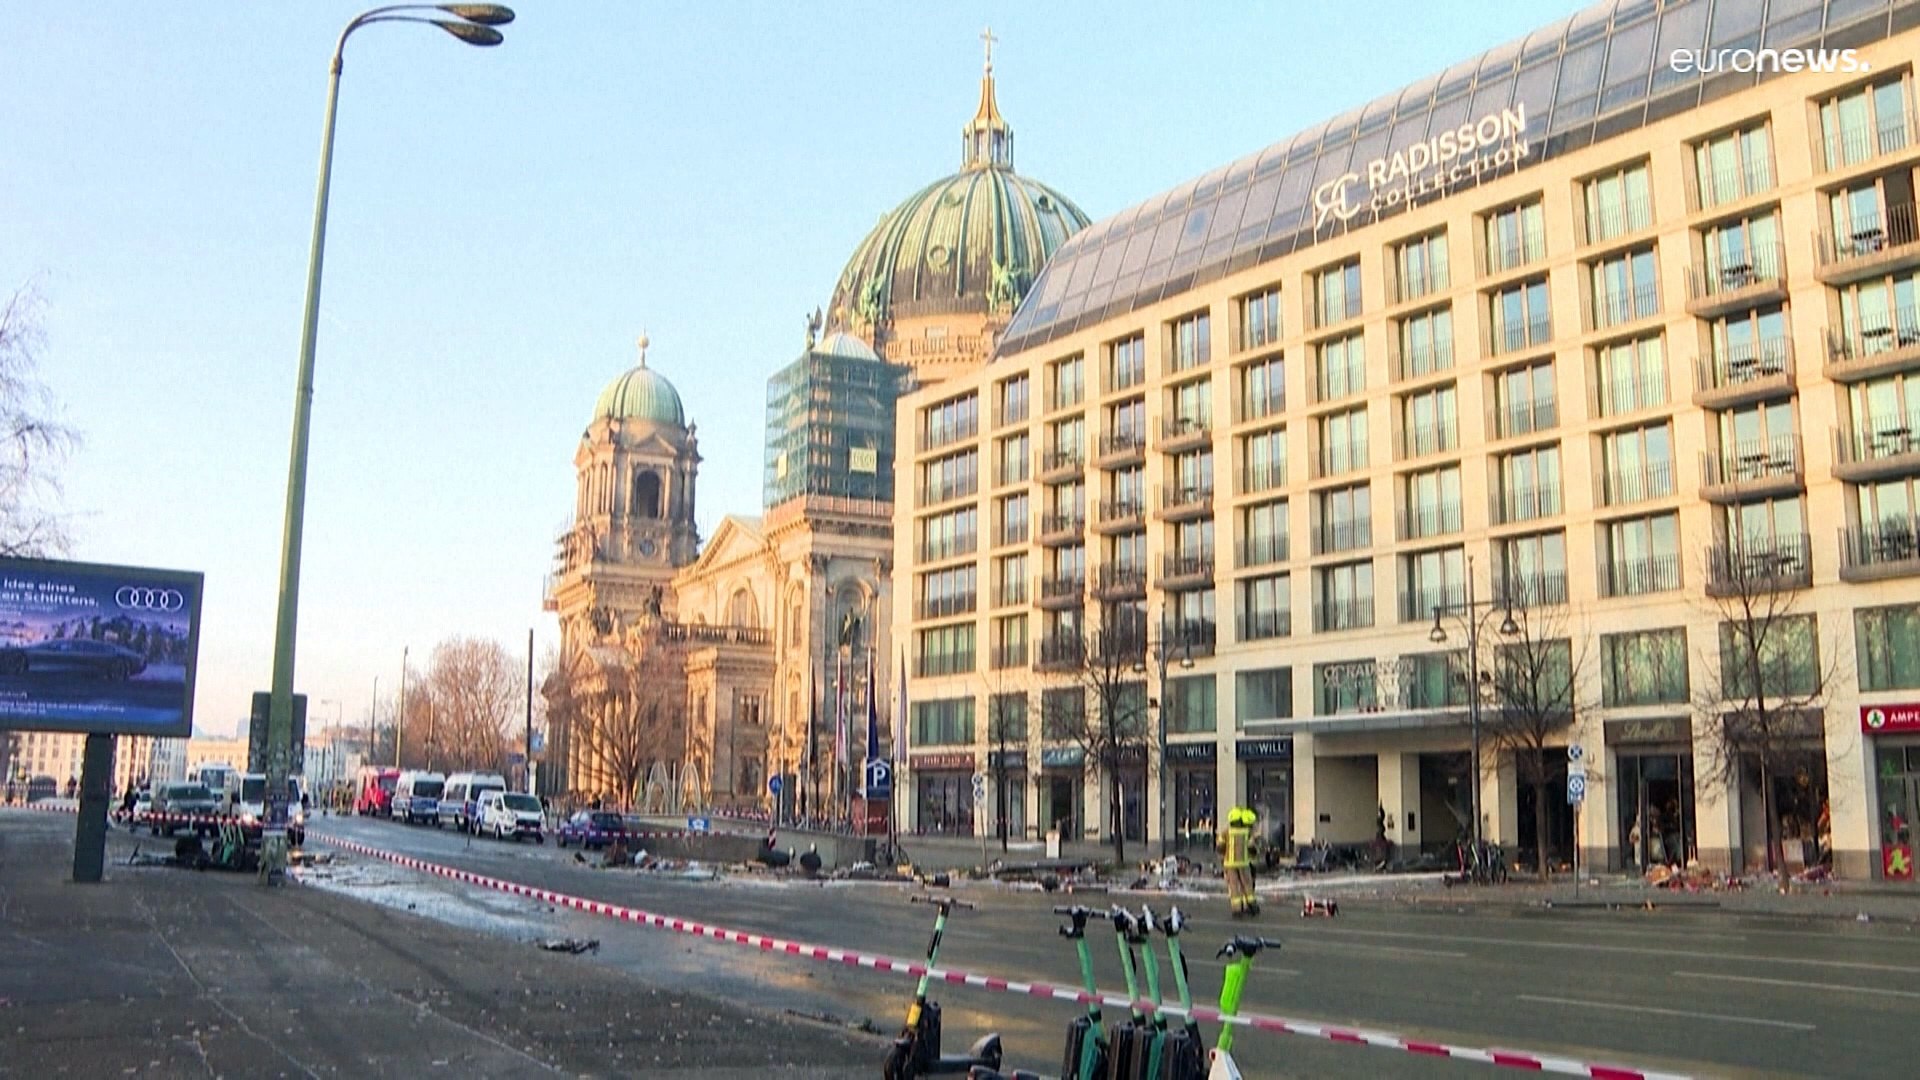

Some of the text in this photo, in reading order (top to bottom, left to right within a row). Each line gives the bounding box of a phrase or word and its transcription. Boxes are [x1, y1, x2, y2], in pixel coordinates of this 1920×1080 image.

[1367, 102, 1526, 191] RADISSON
[1371, 139, 1529, 211] COLLECTION
[873, 767, 886, 788] P
